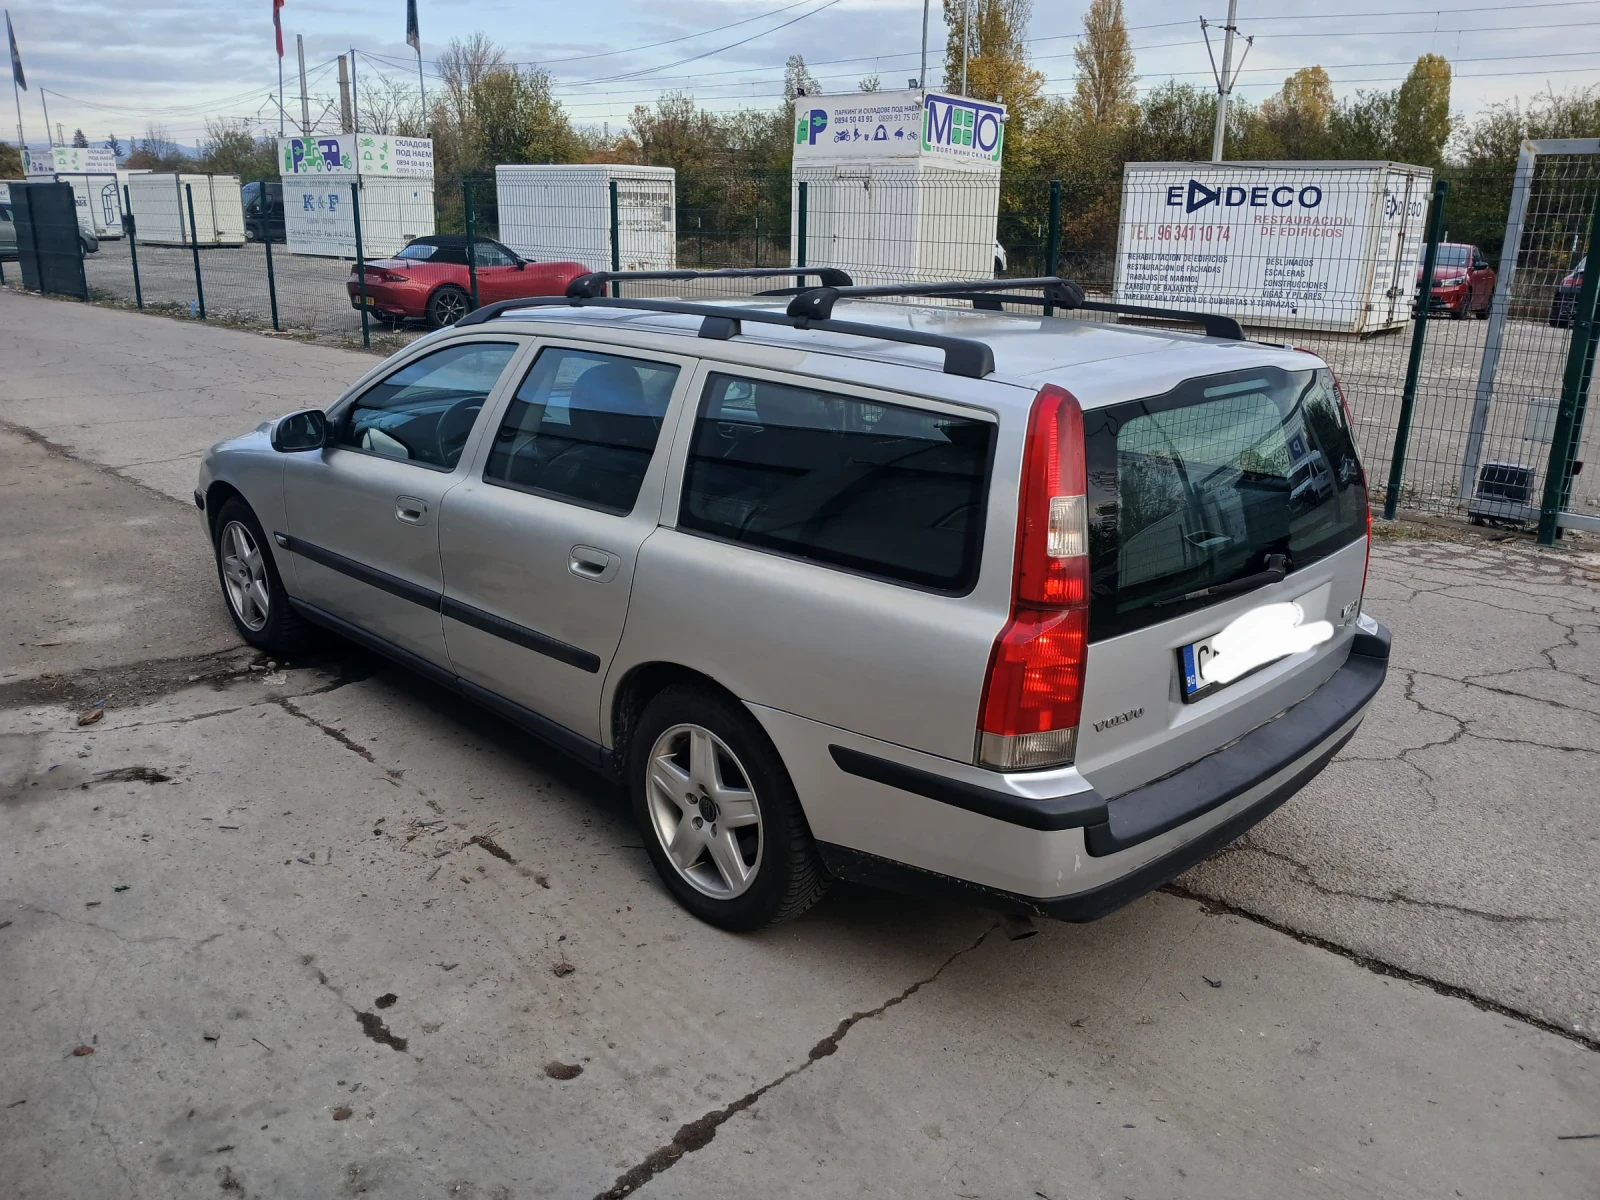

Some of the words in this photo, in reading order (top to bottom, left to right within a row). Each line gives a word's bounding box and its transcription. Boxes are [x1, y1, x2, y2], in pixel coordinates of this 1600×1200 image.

[863, 106, 891, 114] СКЛАДОВЕ
[834, 116, 848, 124] 0894
[857, 115, 865, 123] 43
[865, 115, 873, 123] 91
[878, 114, 893, 122] 0899
[903, 113, 911, 121] 75
[395, 140, 431, 149] СКЛАДОВЕ
[395, 149, 411, 158] ПОД
[412, 150, 432, 158] НАЕМ
[953, 149, 971, 157] МИНИ
[971, 151, 991, 160] СКЛАД
[303, 194, 315, 212] K
[328, 194, 339, 212] F
[1253, 214, 1353, 226] RESTAURACION
[1157, 225, 1171, 241] 96
[1174, 225, 1195, 241] 341
[1199, 226, 1213, 242] 10
[1216, 226, 1230, 242] 74
[1260, 227, 1277, 236] DE
[1280, 227, 1343, 238] EDIFICIOS
[1127, 253, 1181, 261] REHABILITACION
[1184, 254, 1193, 262] DE
[1194, 255, 1228, 264] EDIFICIOS
[1126, 263, 1174, 272] RESTAURACION
[1176, 264, 1185, 272] DE
[1186, 265, 1221, 274] FACHADAS
[1264, 269, 1305, 277] ESCALERAS
[1127, 273, 1158, 281] TRABAJOS
[1169, 275, 1199, 283] MARMOL
[1124, 282, 1150, 291] CAMBIO
[1163, 285, 1198, 293] BAJANTES
[1263, 279, 1328, 290] CONSTRUCCIONES
[1262, 290, 1283, 298] VIGAS
[1291, 291, 1322, 300] PILARES
[1209, 297, 1248, 306] CUBIERTAS
[1256, 300, 1295, 308] TERRAZAS
[1186, 674, 1196, 687] BG
[1093, 706, 1145, 733] VOLVO
